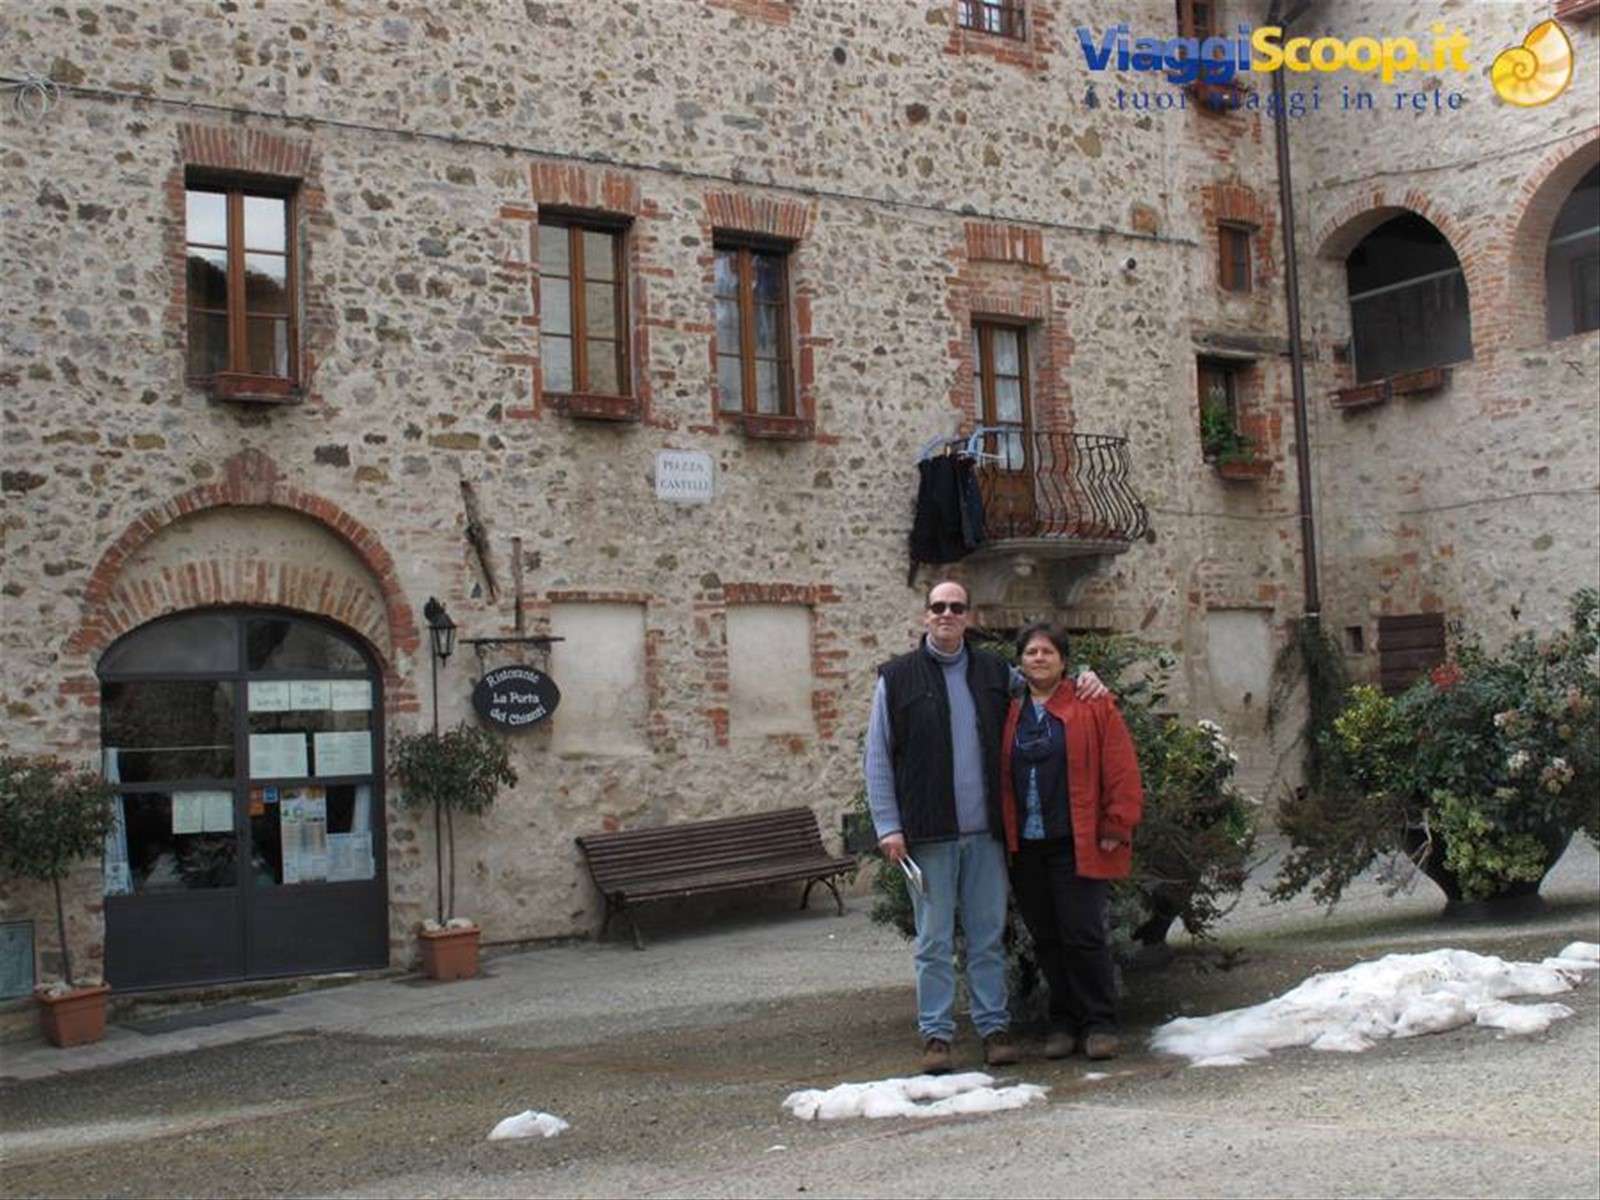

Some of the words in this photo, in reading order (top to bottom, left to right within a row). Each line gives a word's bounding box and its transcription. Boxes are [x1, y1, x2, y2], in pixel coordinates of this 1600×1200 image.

[663, 460, 704, 472] PIAZZA
[486, 669, 539, 687] Ristorante
[493, 692, 507, 703] La
[510, 691, 539, 703] Porta
[508, 704, 546, 725] Chianti
